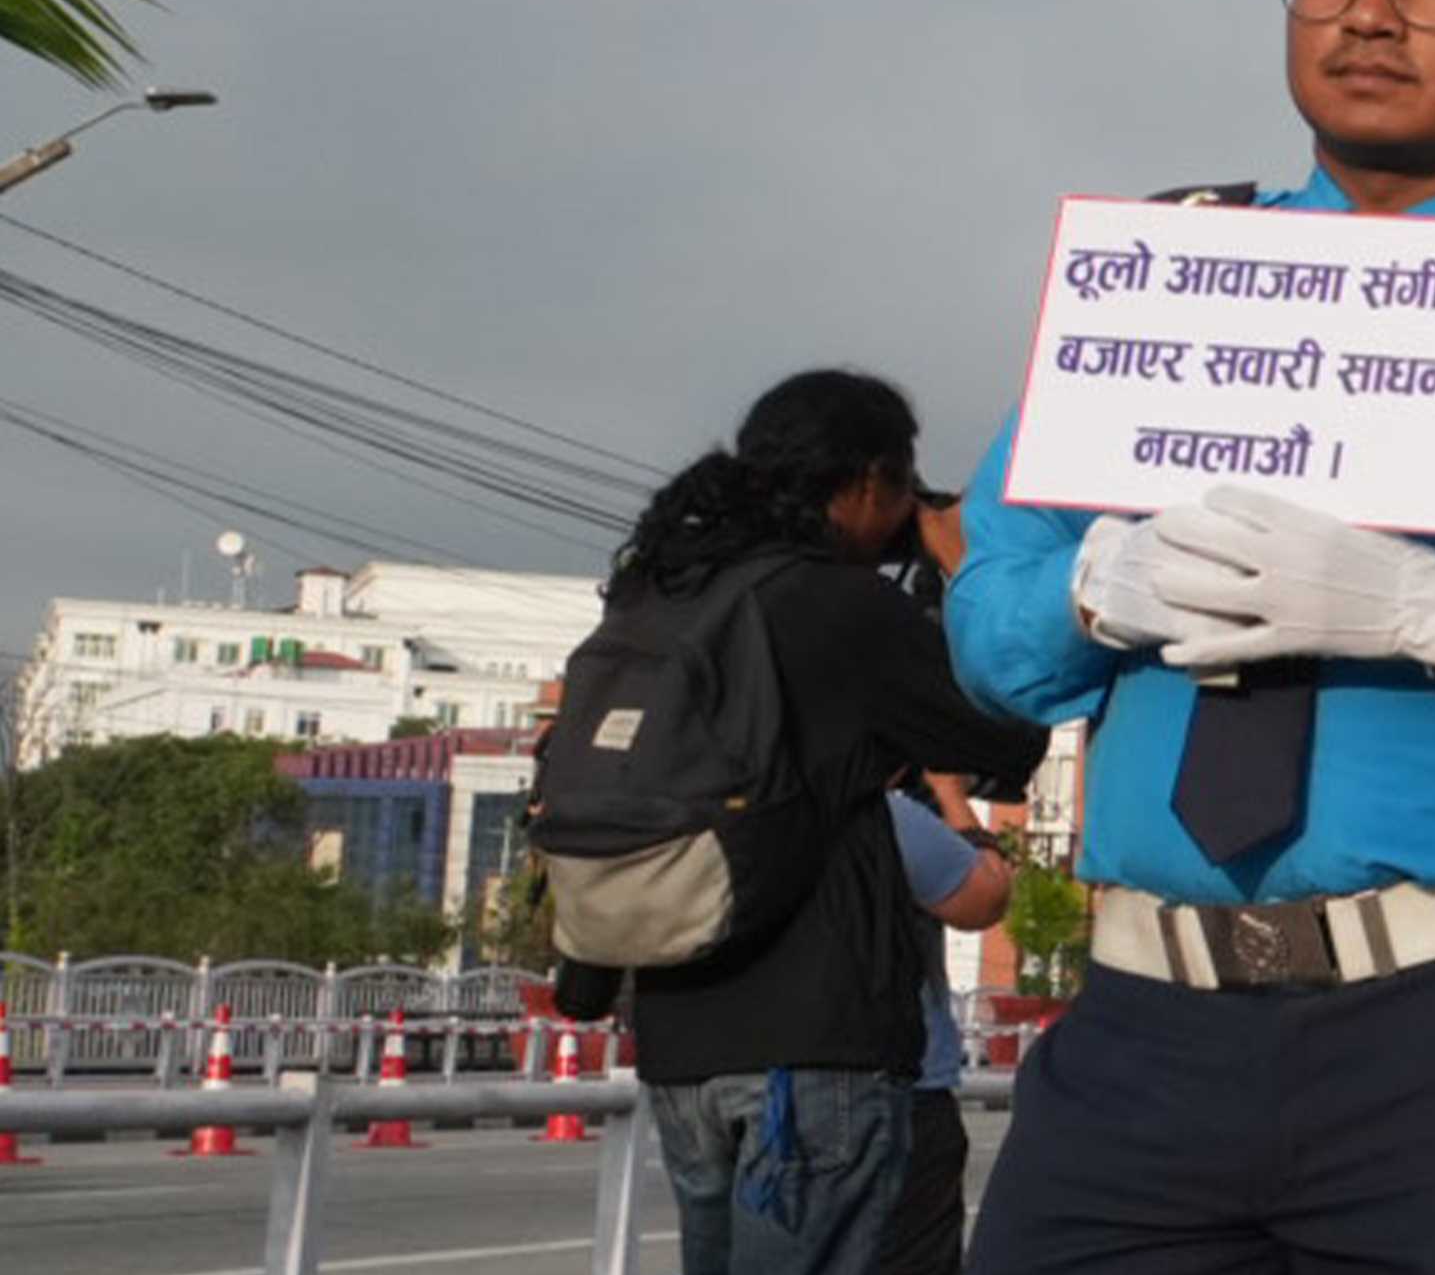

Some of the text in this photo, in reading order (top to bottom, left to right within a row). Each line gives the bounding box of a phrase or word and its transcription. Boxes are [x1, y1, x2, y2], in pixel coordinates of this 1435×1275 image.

[1064, 239, 1153, 301] ठूलो
[1164, 253, 1349, 305] आवाजमा
[1055, 332, 1194, 383] बजाएर
[1204, 337, 1327, 392] सवारी
